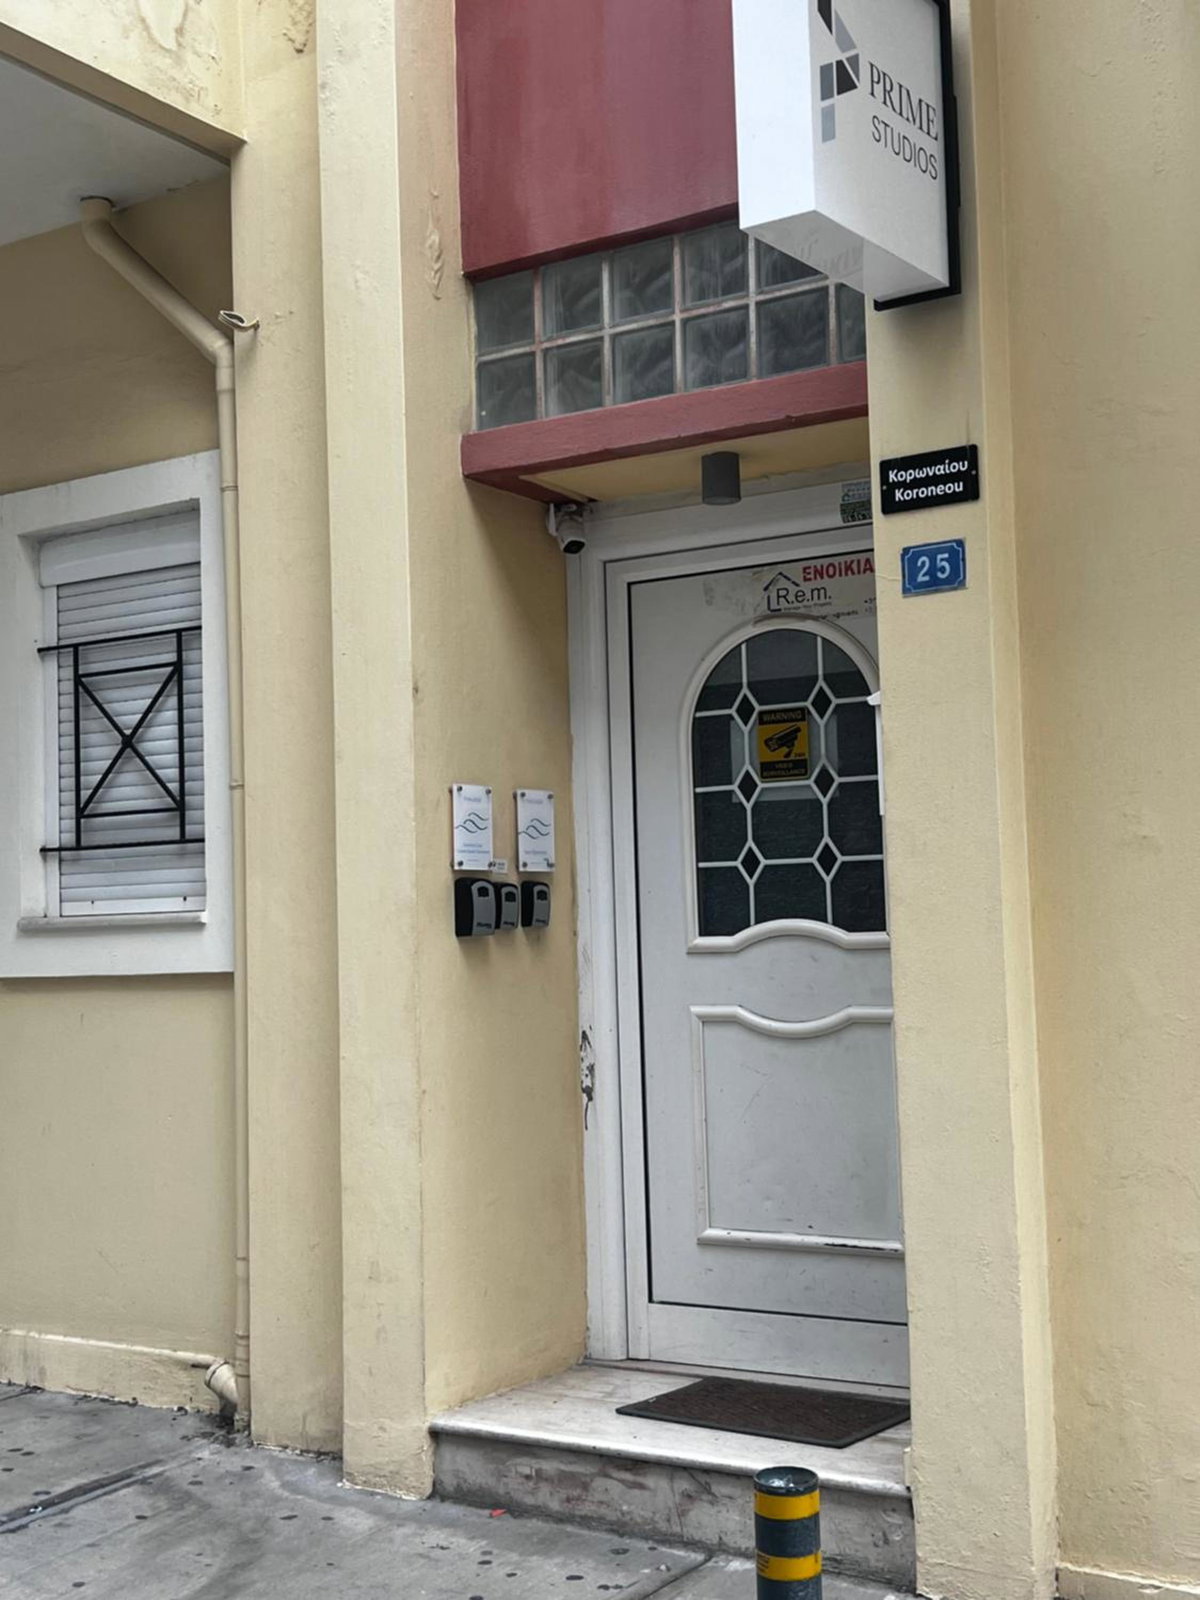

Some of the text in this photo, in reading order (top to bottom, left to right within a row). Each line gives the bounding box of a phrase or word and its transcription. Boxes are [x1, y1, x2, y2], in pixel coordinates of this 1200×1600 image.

[868, 60, 939, 142] PRIME
[871, 115, 938, 180] STUDIOS
[888, 459, 968, 484] Κορωναίου
[894, 481, 964, 502] Koroneou
[916, 552, 951, 583] 25
[776, 585, 832, 606] R.e.m.
[762, 710, 802, 722] WARNING
